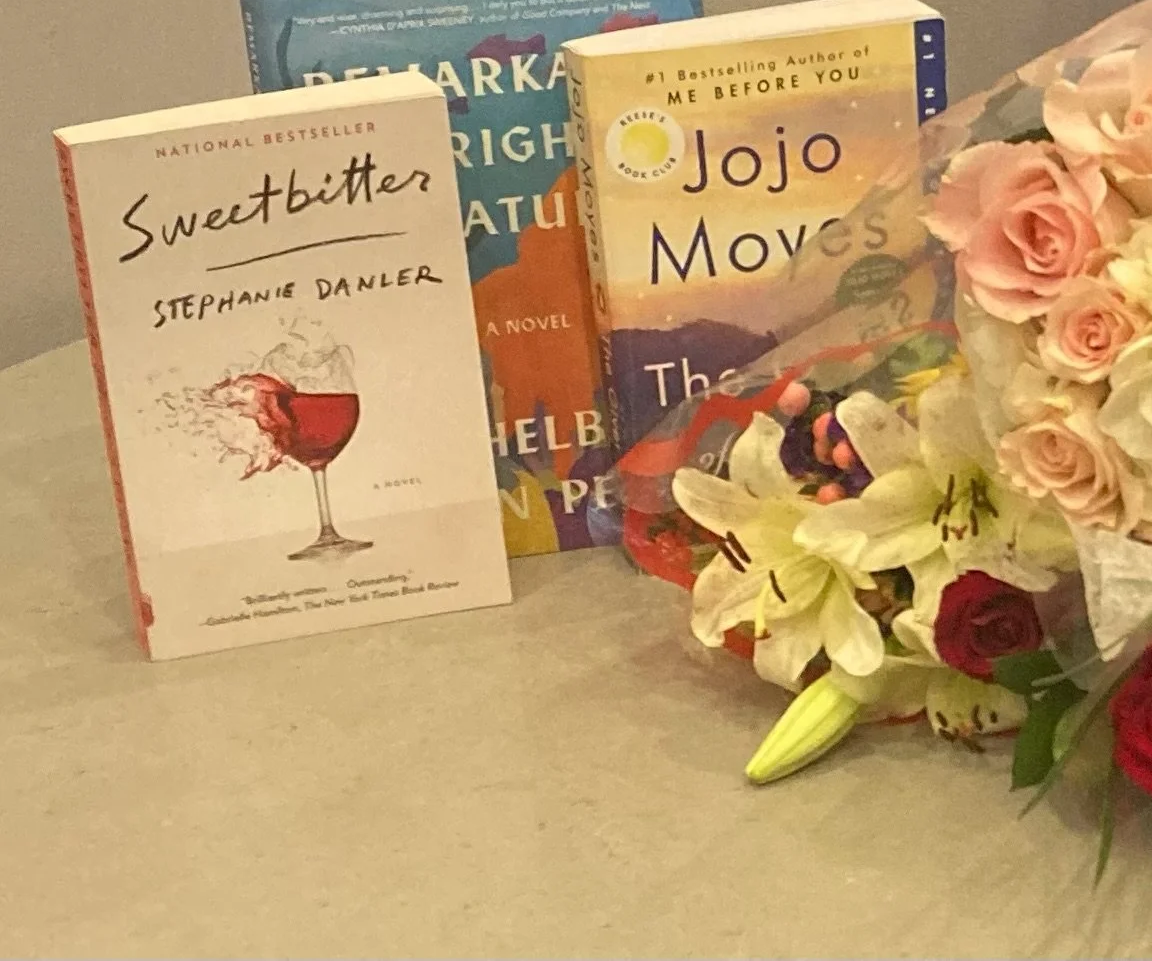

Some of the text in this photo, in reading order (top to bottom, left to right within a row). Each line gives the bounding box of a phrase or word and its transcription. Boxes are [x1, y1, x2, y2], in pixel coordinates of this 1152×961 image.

[645, 45, 870, 86] #1 Bestselling Author of
[667, 66, 861, 107] ME BEFORE YOU
[154, 121, 376, 159] NATIONAL BESTSELLER
[683, 126, 842, 195] Jojo
[618, 157, 677, 180] BOOK CLUB
[118, 153, 432, 264] Sweetbitter
[464, 190, 566, 238] ATU
[651, 212, 890, 286] Moyes
[153, 265, 444, 329] STEPHANIE DANLER
[485, 314, 571, 336] A NOVEL
[372, 477, 423, 491] A NOVEL
